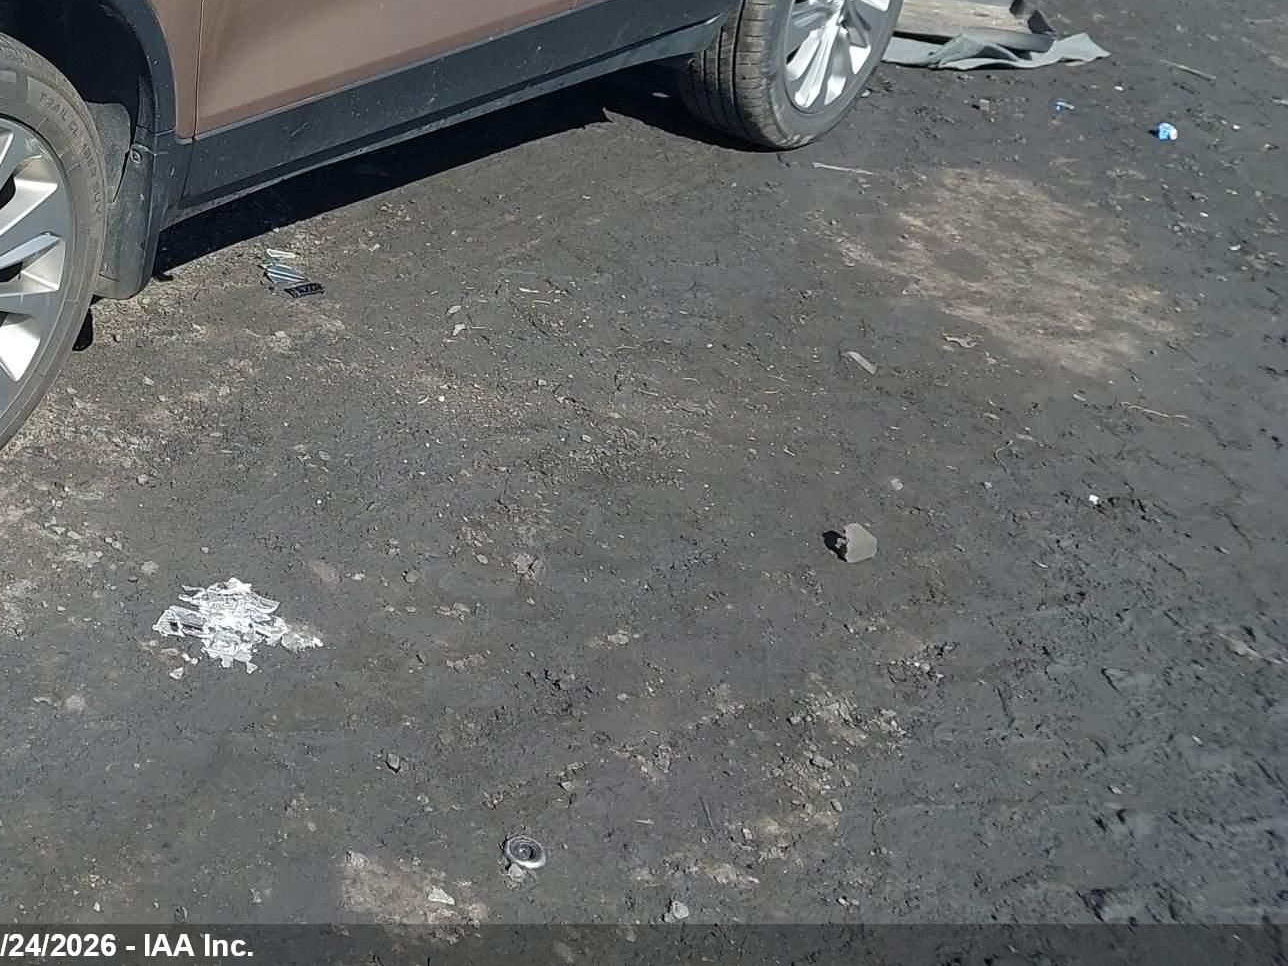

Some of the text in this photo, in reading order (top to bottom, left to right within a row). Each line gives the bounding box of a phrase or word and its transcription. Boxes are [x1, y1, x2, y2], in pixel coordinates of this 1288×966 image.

[39, 92, 102, 214] TRAIL CLBER SUV
